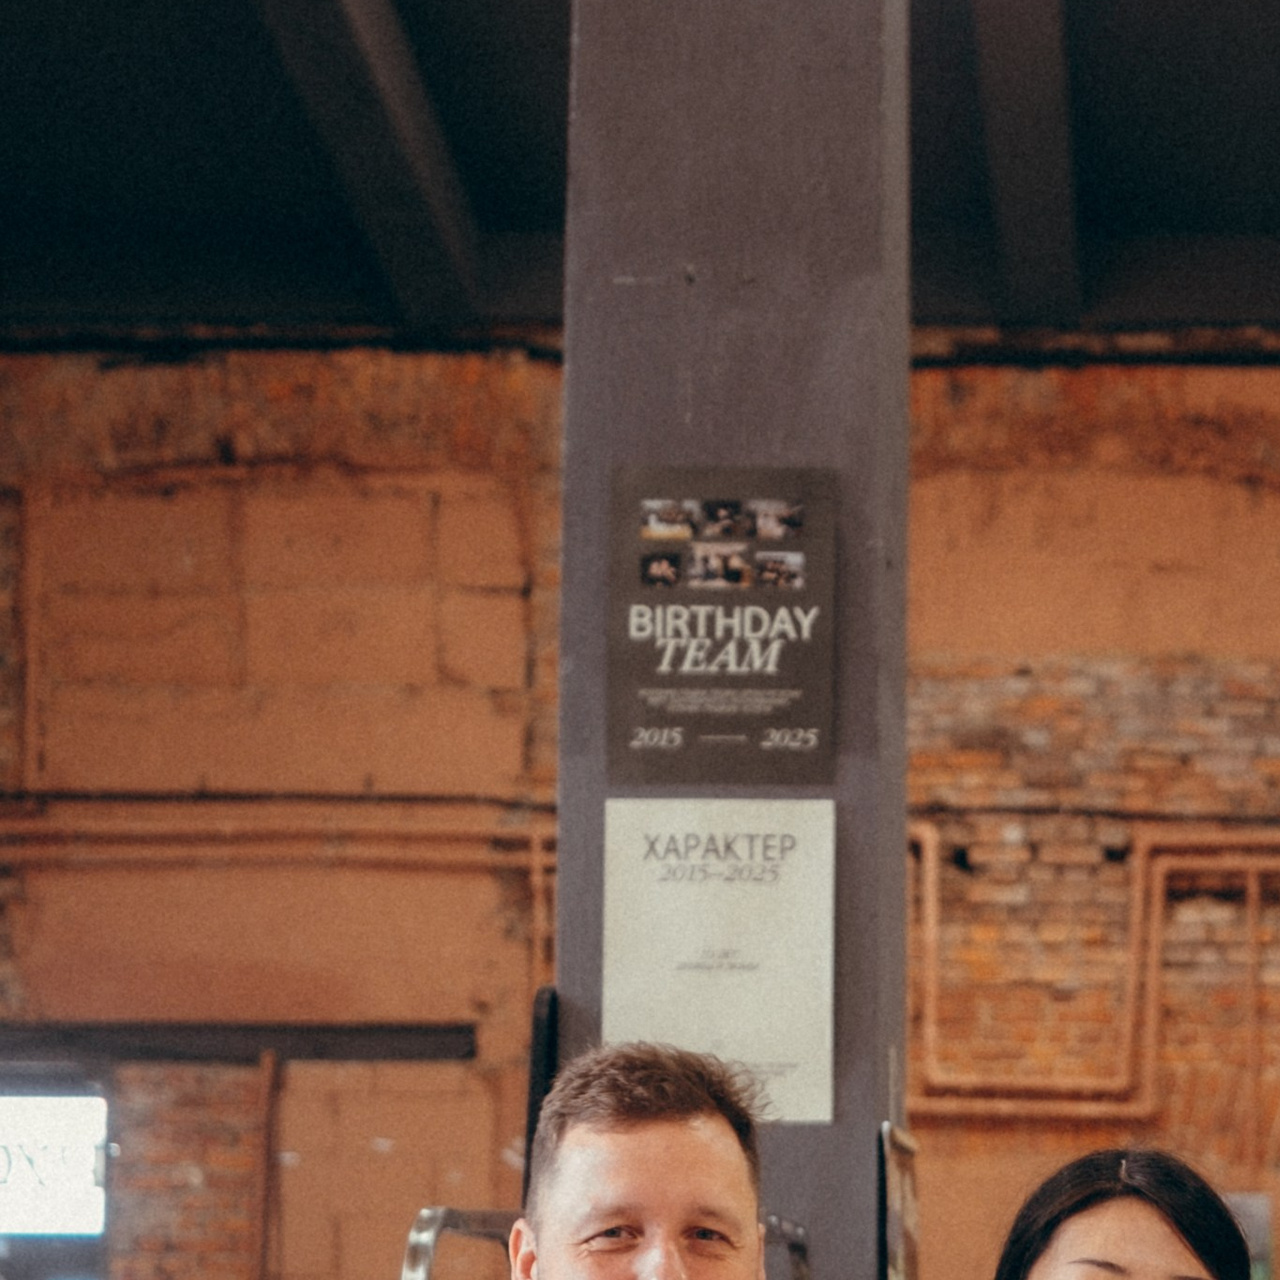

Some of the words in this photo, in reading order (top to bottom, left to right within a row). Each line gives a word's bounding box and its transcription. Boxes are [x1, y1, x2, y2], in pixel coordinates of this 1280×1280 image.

[628, 604, 820, 640] BIRTHDAY
[655, 637, 786, 675] TEAM
[629, 727, 684, 749] 2015
[759, 728, 820, 749] 2025
[642, 833, 797, 861] ХАРАКТЕР
